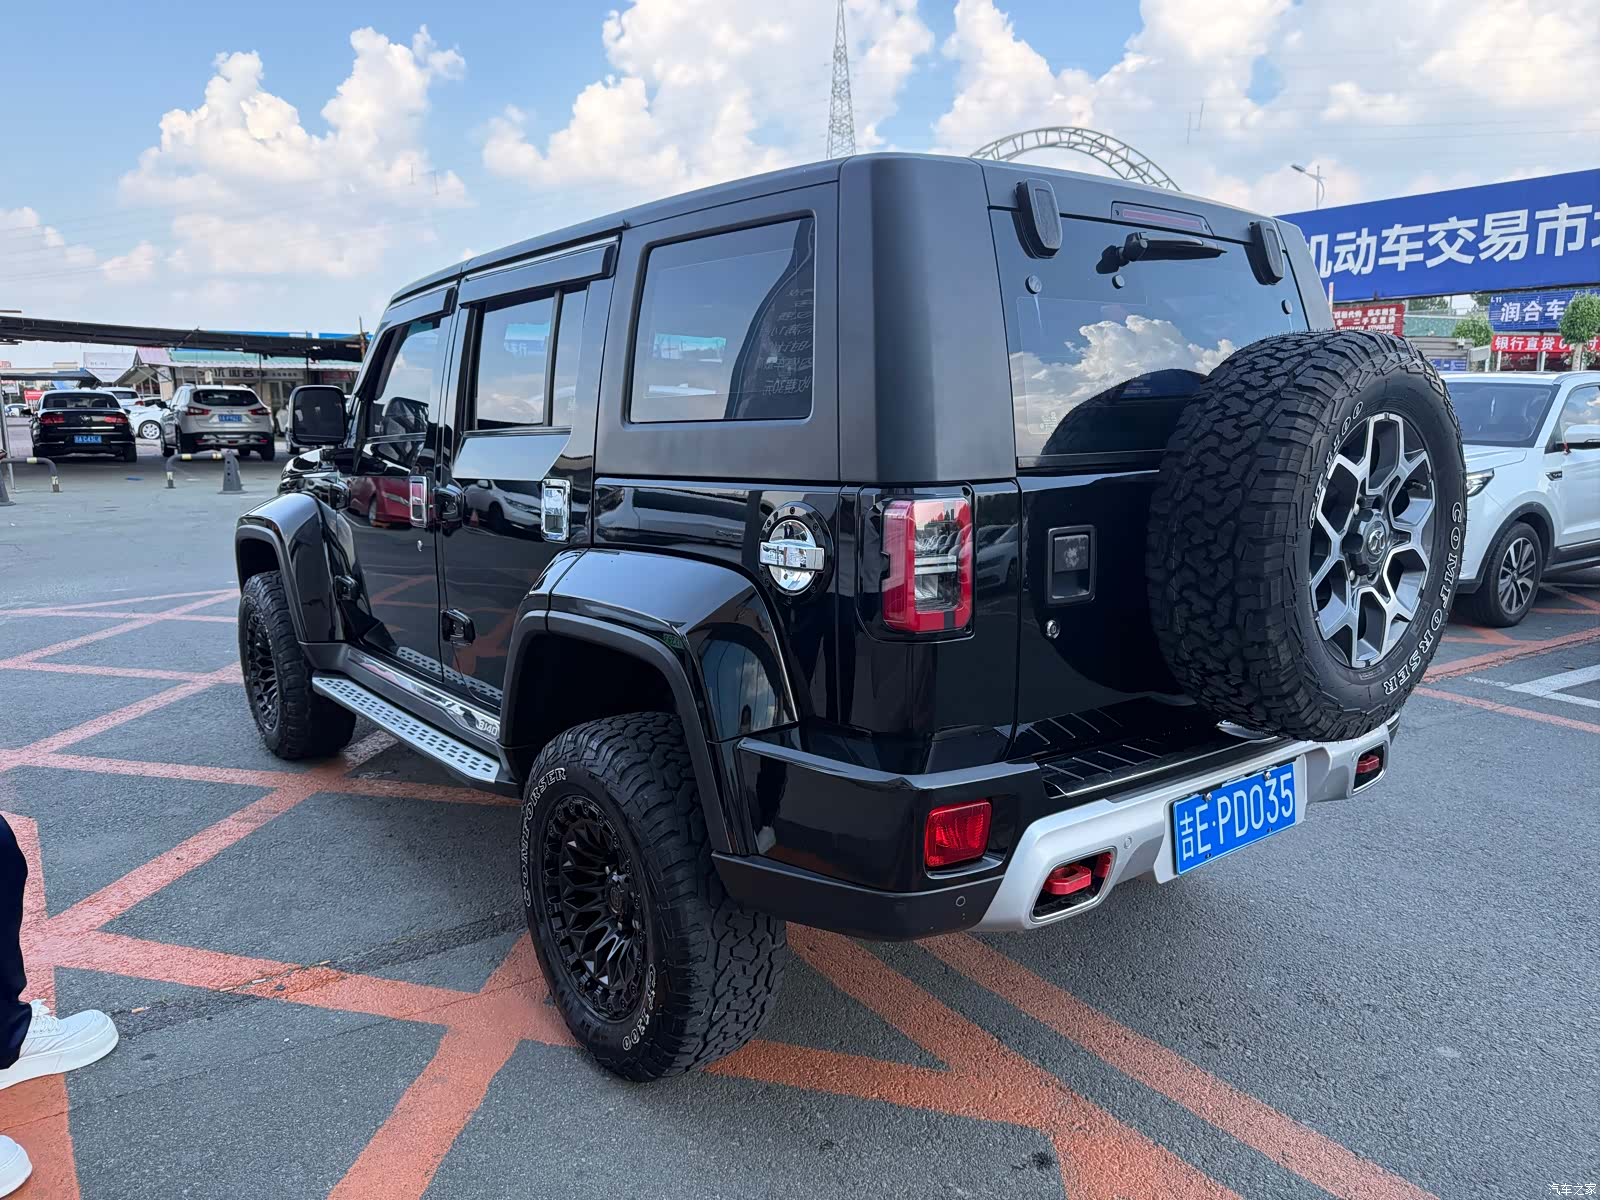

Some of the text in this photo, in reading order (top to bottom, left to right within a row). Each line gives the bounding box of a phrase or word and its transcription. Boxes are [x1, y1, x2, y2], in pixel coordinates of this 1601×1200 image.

[1306, 202, 1600, 279] 机动车交易市
[1495, 336, 1556, 351] 银行直贷
[1383, 501, 1463, 695] COMFORSER
[479, 720, 499, 737] BJ40
[521, 767, 567, 908] COMFORSER
